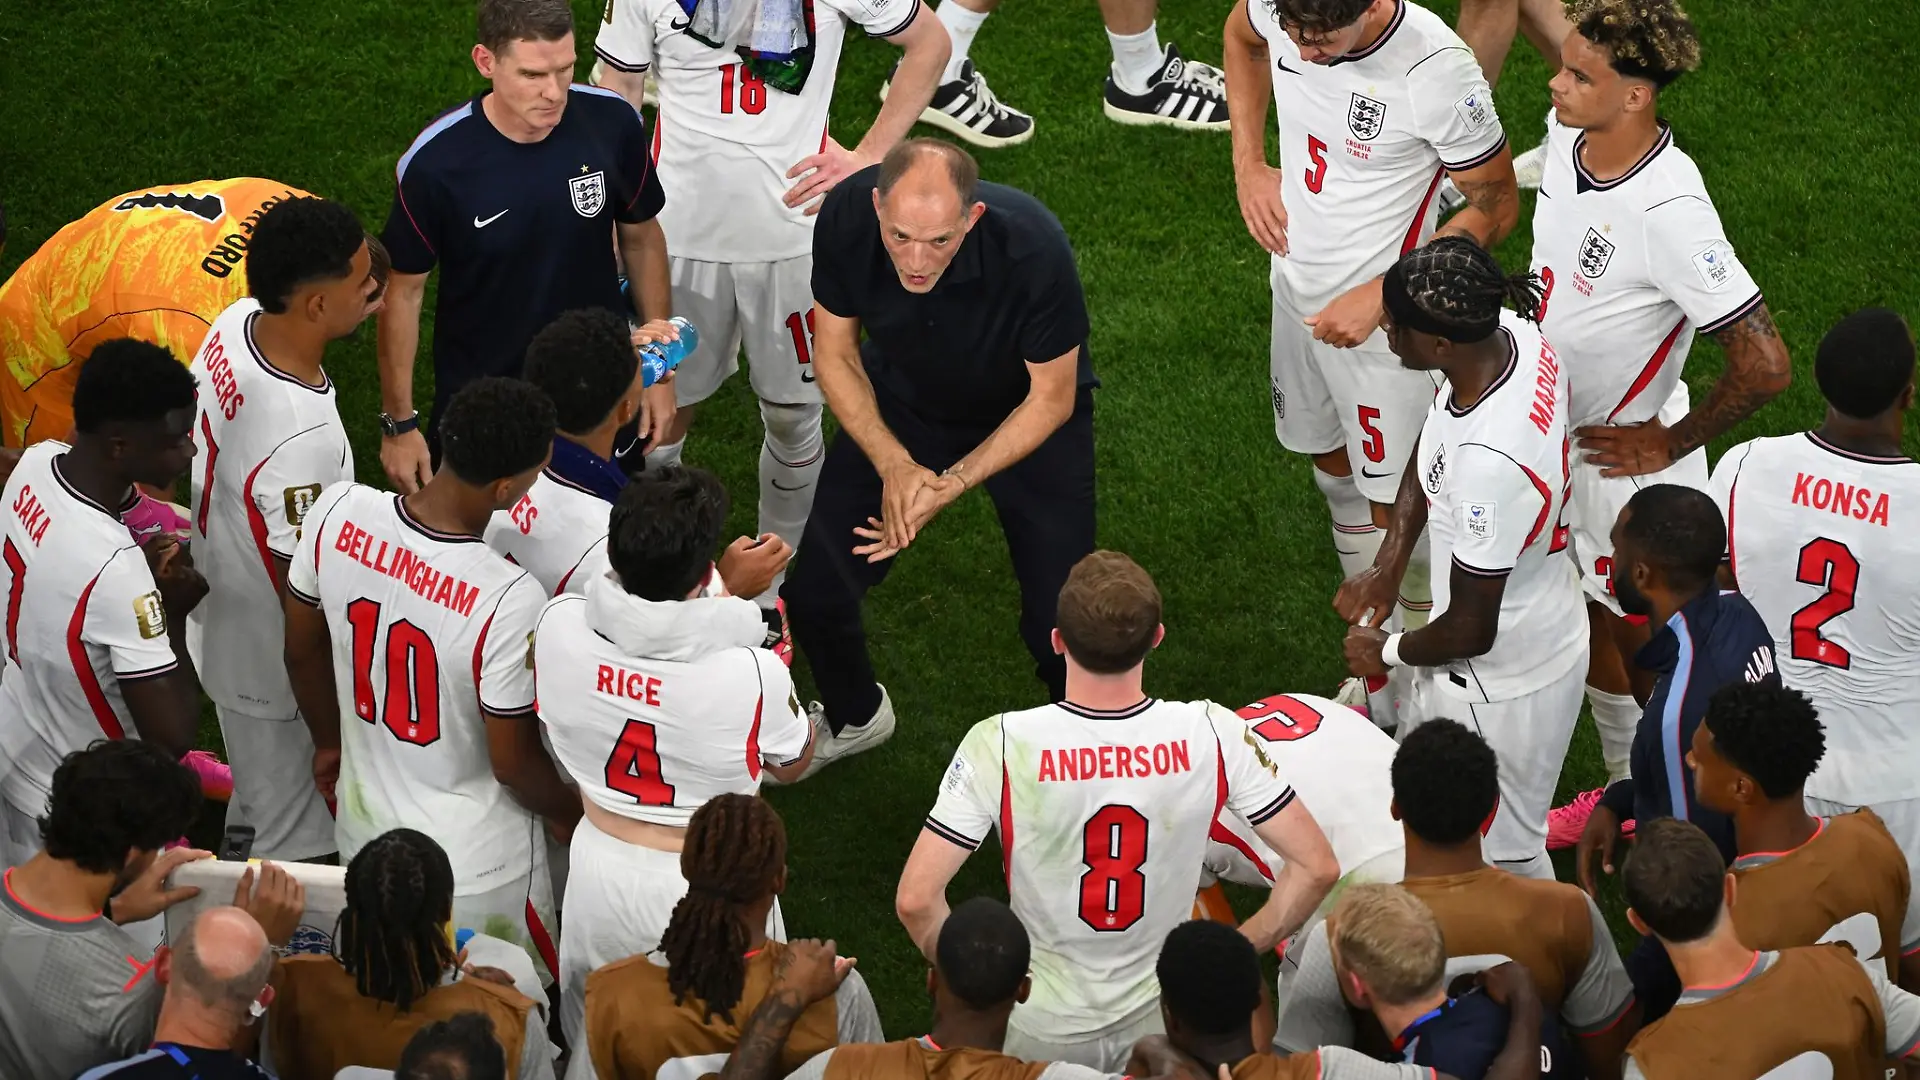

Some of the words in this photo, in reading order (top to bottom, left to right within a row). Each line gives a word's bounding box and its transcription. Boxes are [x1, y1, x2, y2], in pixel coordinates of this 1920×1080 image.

[719, 63, 767, 115] 18
[1304, 133, 1328, 195] 5
[1345, 138, 1372, 153] CROATIA
[111, 193, 224, 222] 1
[201, 190, 304, 279] FORD
[1573, 271, 1593, 291] CROATIA
[785, 307, 816, 364] 1
[203, 331, 244, 421] ROGERS
[1357, 404, 1386, 463] 5
[13, 484, 51, 548] SAKA
[507, 493, 538, 535] ES
[1469, 523, 1486, 533] PEACE
[1791, 472, 1890, 527] KONSA
[335, 520, 481, 618] BELLINGHAM
[3, 533, 27, 671] 7
[1790, 536, 1861, 671] 2
[347, 597, 441, 747] 10
[596, 664, 662, 707] RICE
[604, 718, 675, 807] 4
[1038, 739, 1191, 782] ANDERSON
[1078, 803, 1149, 932] 8
